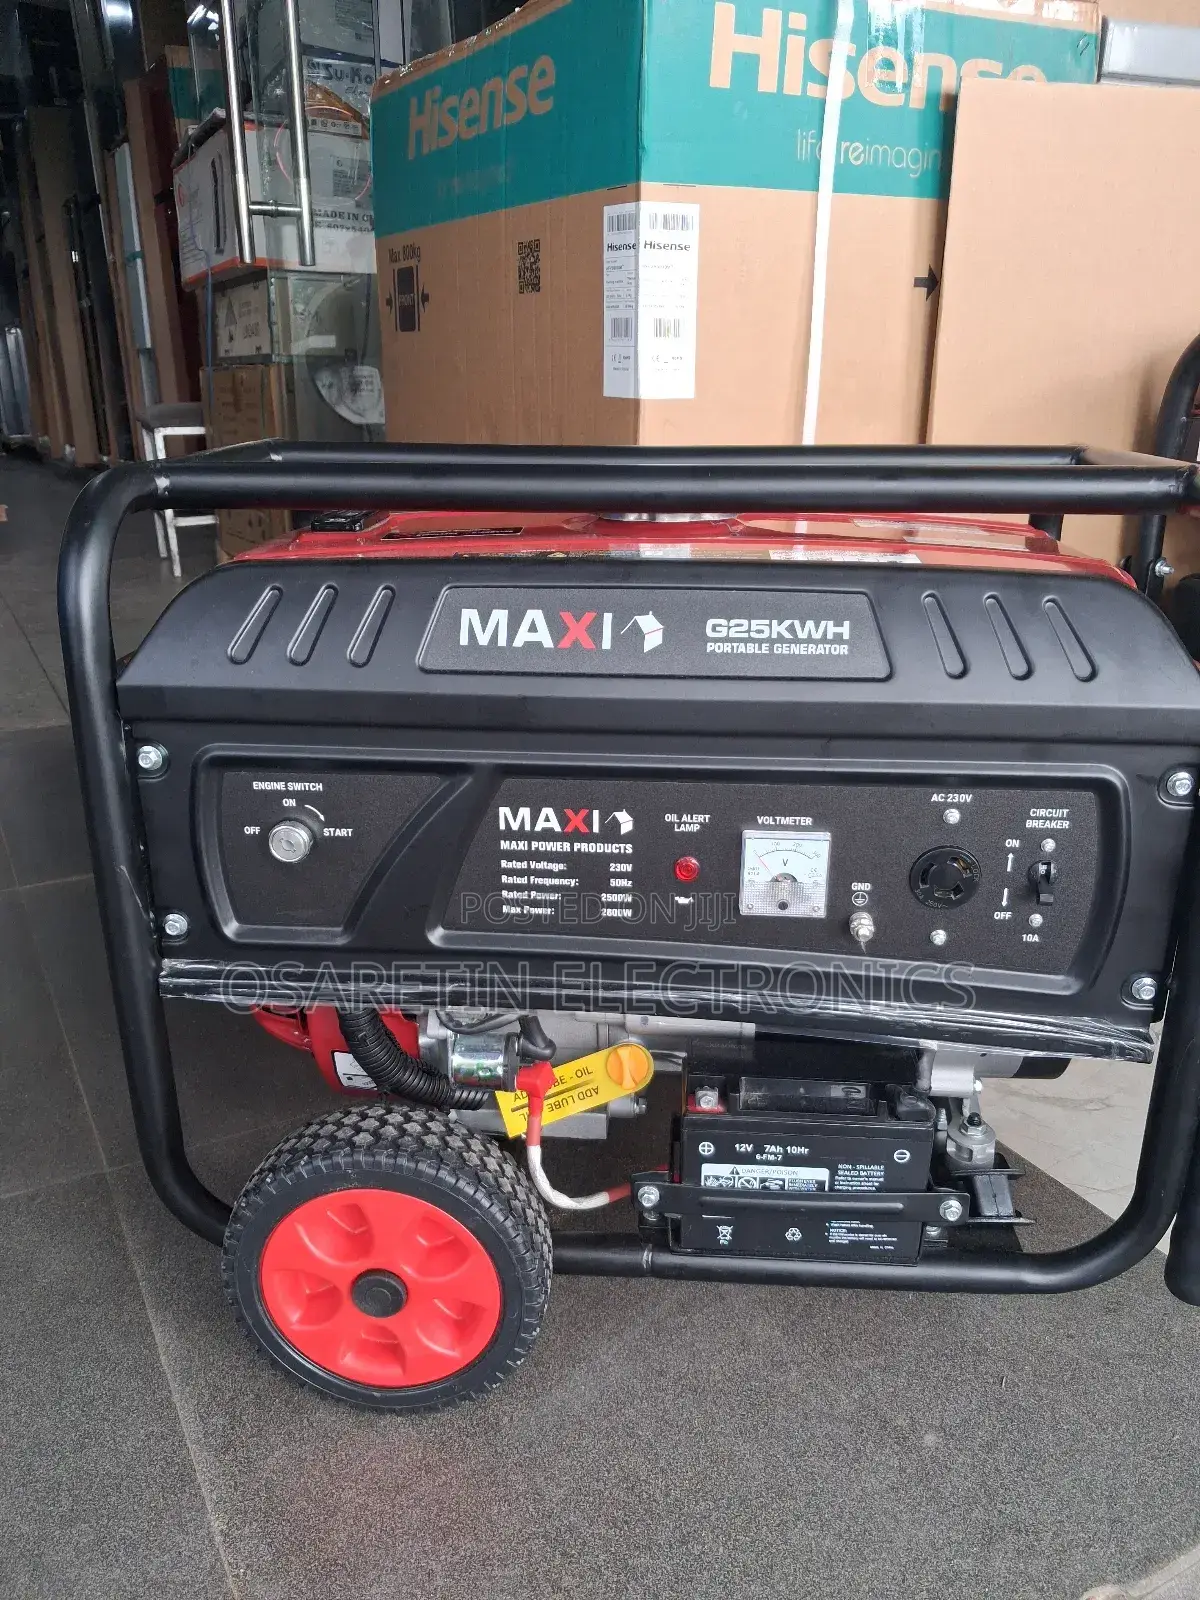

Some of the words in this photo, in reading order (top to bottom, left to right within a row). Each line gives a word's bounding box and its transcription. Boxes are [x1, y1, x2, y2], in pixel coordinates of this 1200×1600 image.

[408, 54, 556, 161] Hisense
[606, 242, 637, 252] Hisense
[643, 240, 691, 252] Hisense
[459, 608, 613, 650] MAXI
[705, 618, 850, 640] G25KWH
[706, 642, 770, 654] PORTABLE
[773, 643, 849, 655] GENERATOR
[253, 781, 286, 791] ENGINE
[287, 782, 323, 791] SWITCH
[282, 798, 297, 807] ON
[931, 793, 945, 802] AC
[947, 793, 973, 803] 230V
[664, 813, 680, 823] OIL
[681, 814, 711, 823] ALERT
[1029, 808, 1069, 818] CIRCUIT
[498, 806, 600, 834] MAXI
[757, 815, 813, 826] VOLTMETER
[1026, 819, 1070, 829] BREAKER
[244, 826, 261, 835] OFF
[323, 827, 354, 837] START
[674, 823, 701, 833] LAMP
[500, 840, 528, 851] MAXI
[531, 841, 571, 852] POWER
[573, 842, 633, 854] PRODUCTS
[1005, 839, 1020, 848] ON
[500, 859, 528, 870] Rated
[529, 860, 567, 872] Voltage:
[609, 863, 633, 872] 230V
[782, 858, 789, 867] V
[501, 874, 528, 885] Rated
[530, 876, 579, 888] Frequency:
[609, 878, 633, 888] 50Hz
[851, 882, 872, 892] GND
[501, 889, 528, 900] Rated
[530, 890, 562, 901] Power:
[600, 892, 632, 903] 2500W
[502, 904, 521, 915] Max
[523, 905, 555, 916] Power:
[993, 911, 1012, 920] OFF
[1022, 933, 1040, 942] 10A
[575, 1066, 594, 1078] OIL
[577, 1085, 599, 1101] ADD
[545, 1094, 576, 1112] LUBE
[734, 1143, 754, 1152] 12V
[763, 1144, 784, 1153] 7Ah
[785, 1145, 810, 1155] 10Hr
[755, 1153, 783, 1161] 6-FM-7
[741, 1168, 799, 1176] DANGER/POISON
